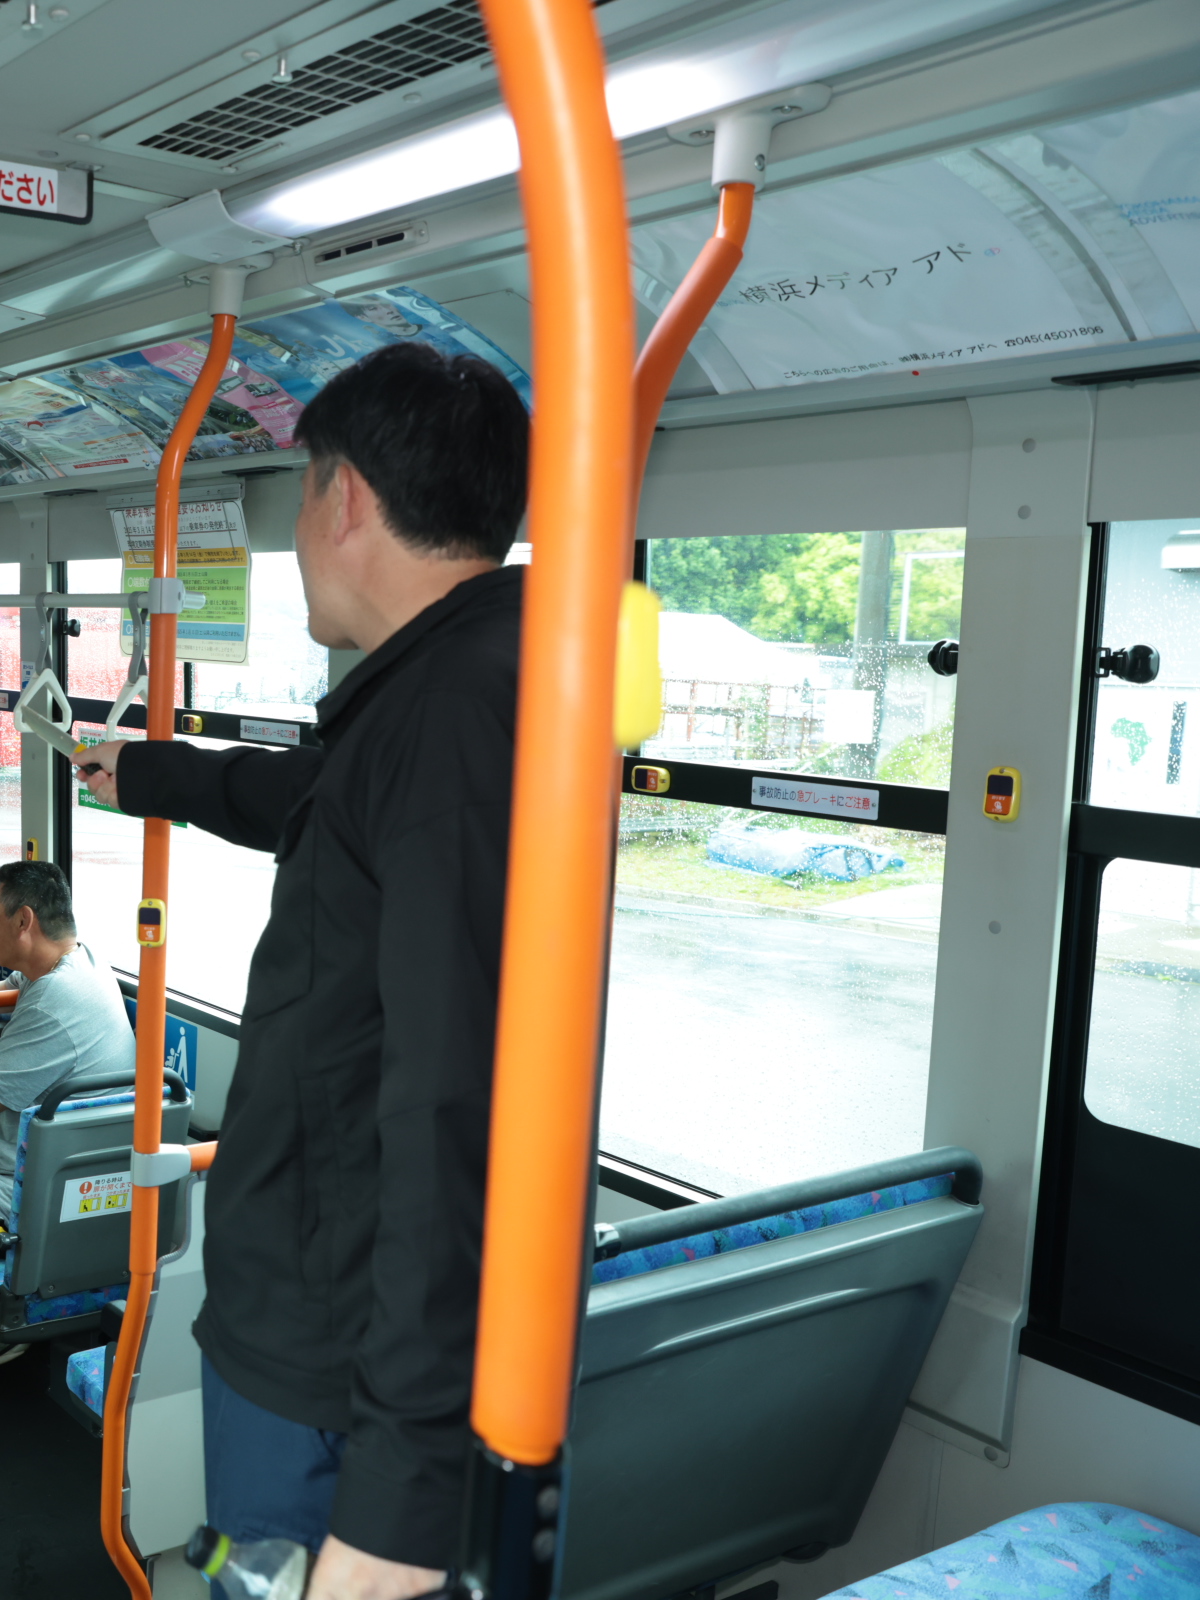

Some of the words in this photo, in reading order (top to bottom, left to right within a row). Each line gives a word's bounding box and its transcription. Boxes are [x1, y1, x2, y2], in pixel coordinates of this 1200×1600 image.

[759, 785, 871, 810] 事故防止の急ブレーキにご注意
[95, 1176, 123, 1185] 降りる時は
